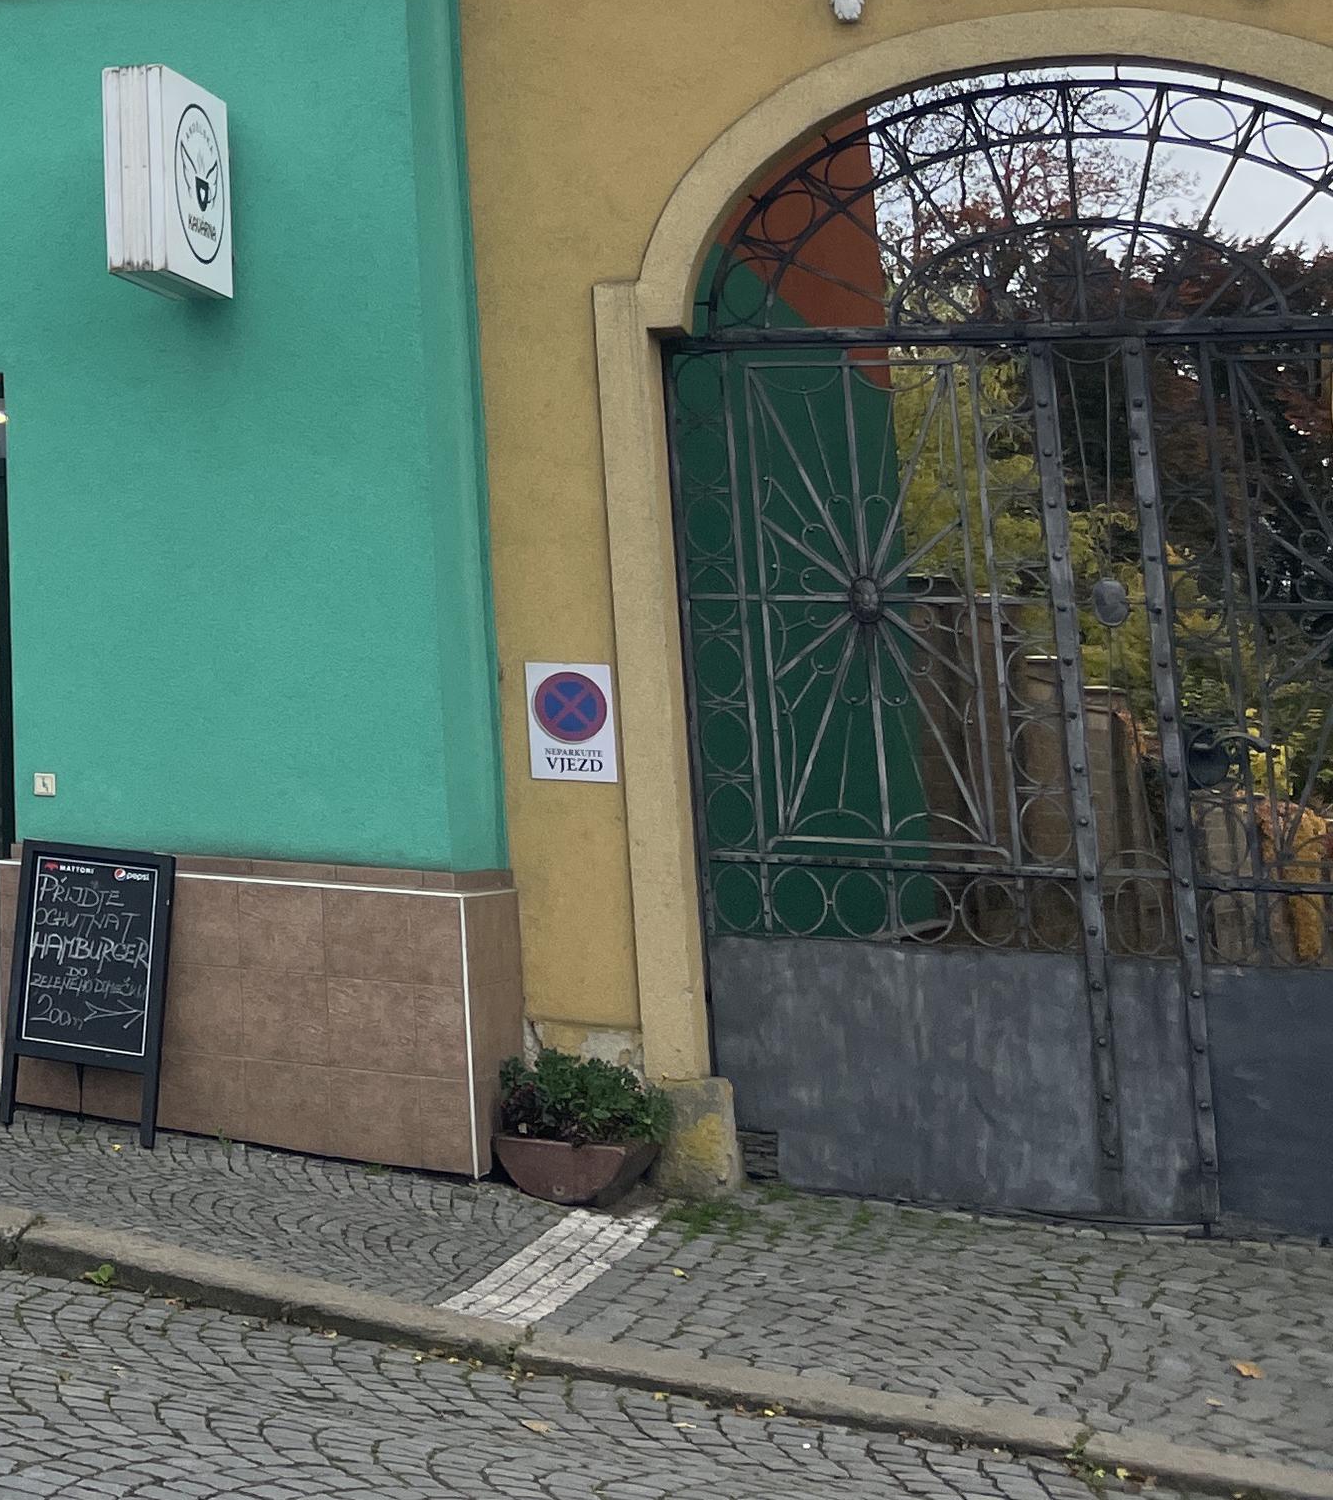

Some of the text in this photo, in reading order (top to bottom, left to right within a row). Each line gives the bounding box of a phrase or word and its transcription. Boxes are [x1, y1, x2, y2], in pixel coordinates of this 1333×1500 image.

[544, 747, 603, 758] NEPARKUJTE
[546, 757, 604, 774] VJEZD
[59, 864, 95, 875] MATTONI
[126, 871, 150, 882] pepsi
[34, 907, 141, 943] OCHUTNAT
[31, 931, 150, 974] HAMBURGER
[65, 966, 88, 977] DO
